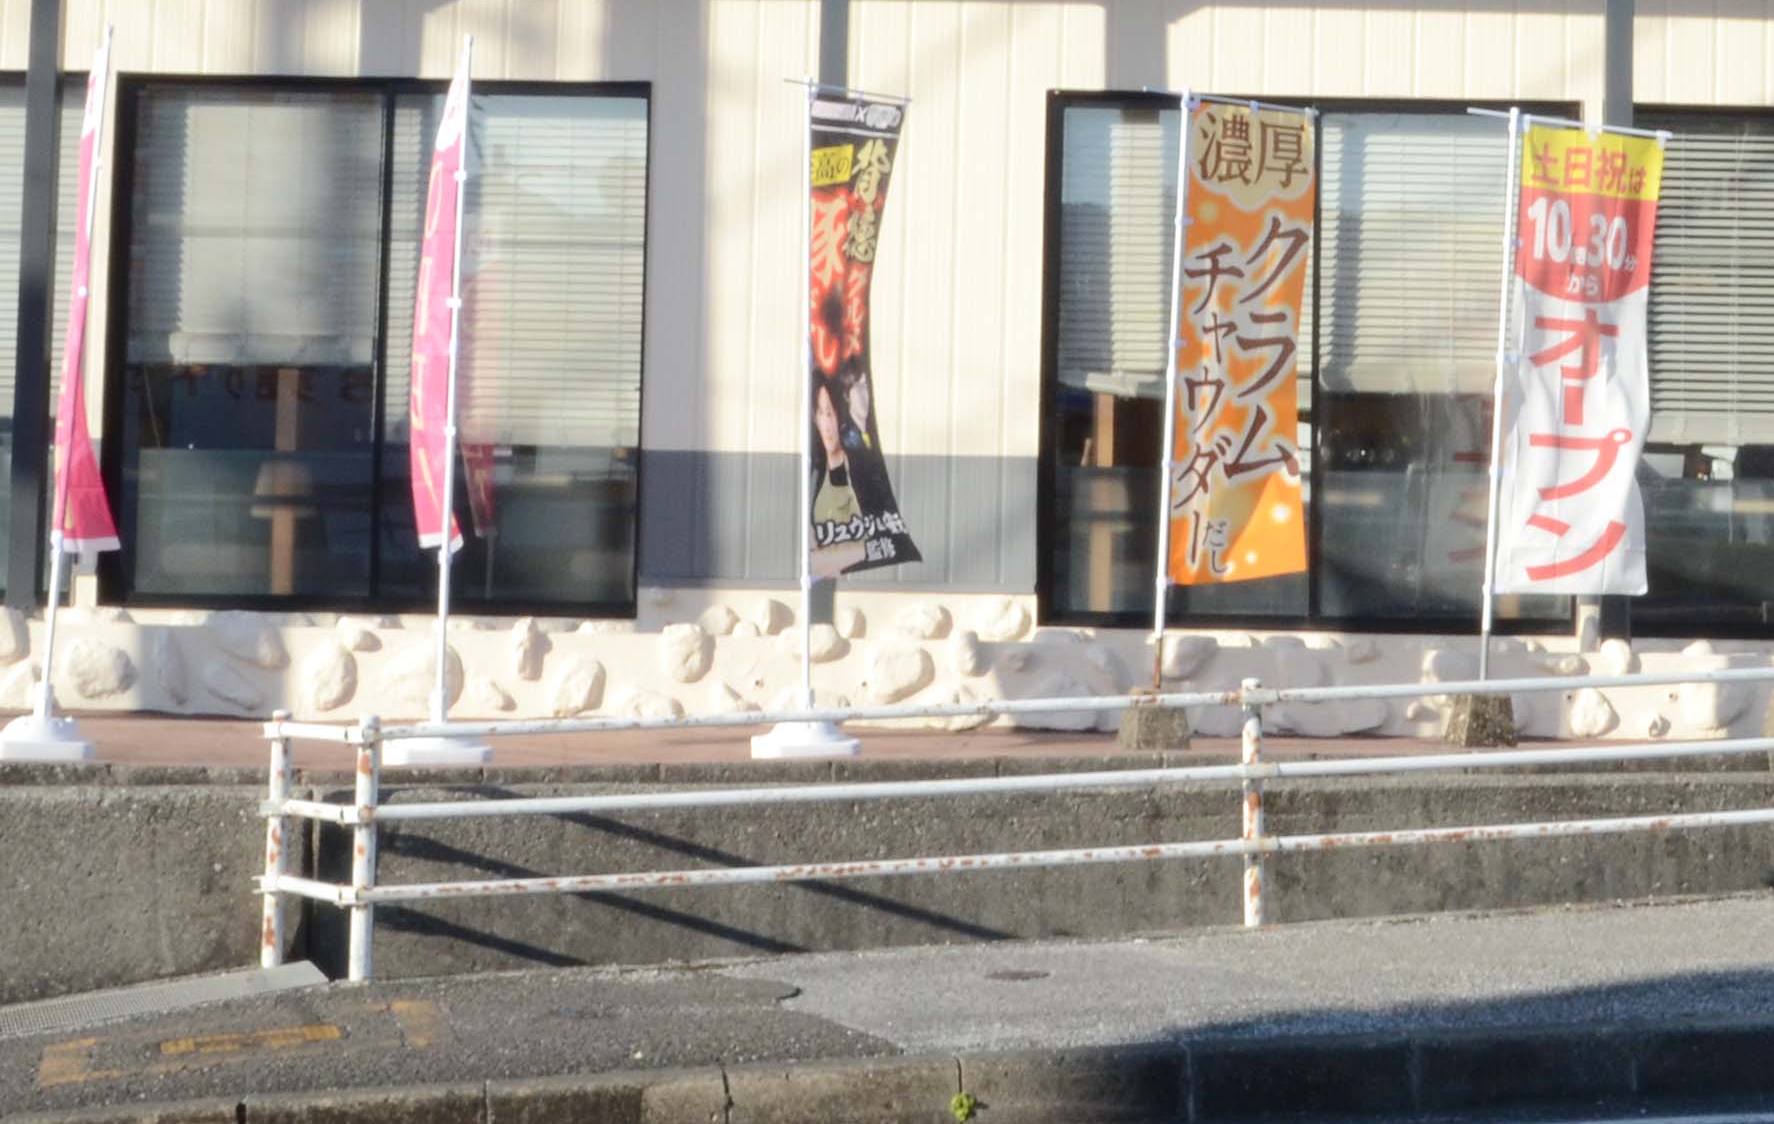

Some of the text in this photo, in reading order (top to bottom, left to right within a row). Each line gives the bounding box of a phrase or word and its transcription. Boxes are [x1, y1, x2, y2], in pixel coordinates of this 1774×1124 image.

[1200, 113, 1308, 188] 濃厚
[1531, 140, 1647, 194] 土日祝は
[1567, 273, 1601, 297] から
[1223, 215, 1309, 481] クラム
[1525, 310, 1632, 582] オープン
